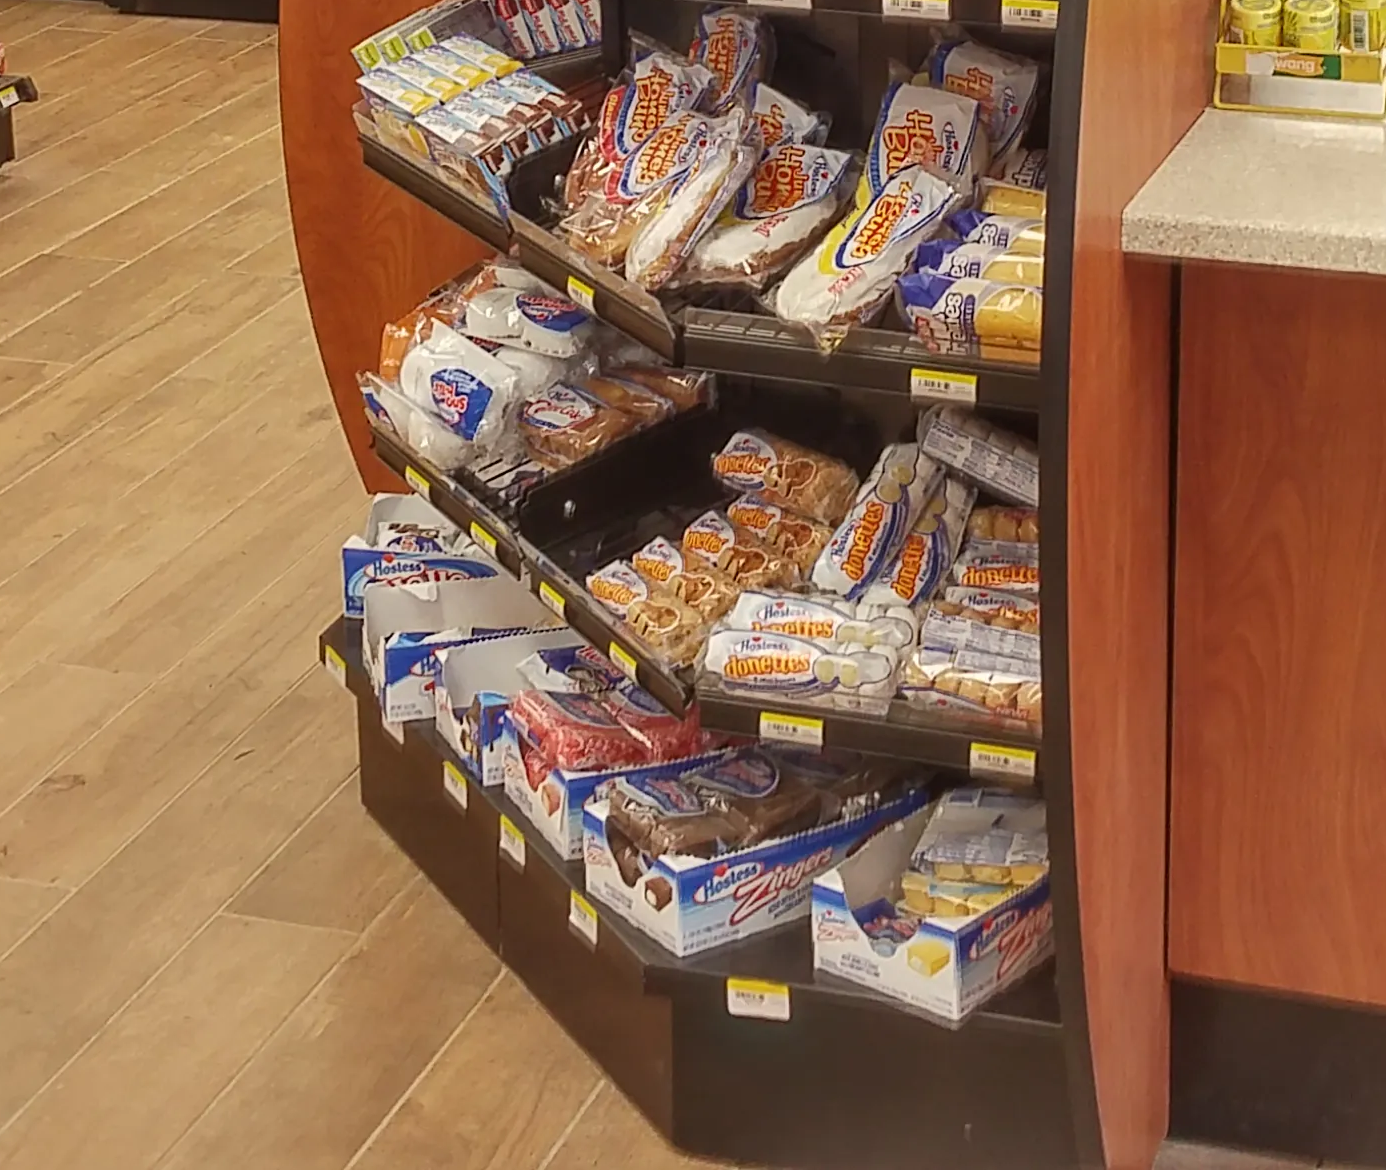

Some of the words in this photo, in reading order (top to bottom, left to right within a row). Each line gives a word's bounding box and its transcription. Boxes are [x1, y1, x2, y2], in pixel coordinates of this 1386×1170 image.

[839, 500, 886, 582] donettes
[372, 560, 423, 576] Hostess
[963, 567, 1038, 588] donette
[740, 639, 790, 654] Hostess
[723, 653, 810, 681] donettes
[702, 863, 761, 902] Hostess
[729, 847, 834, 927] Zingers
